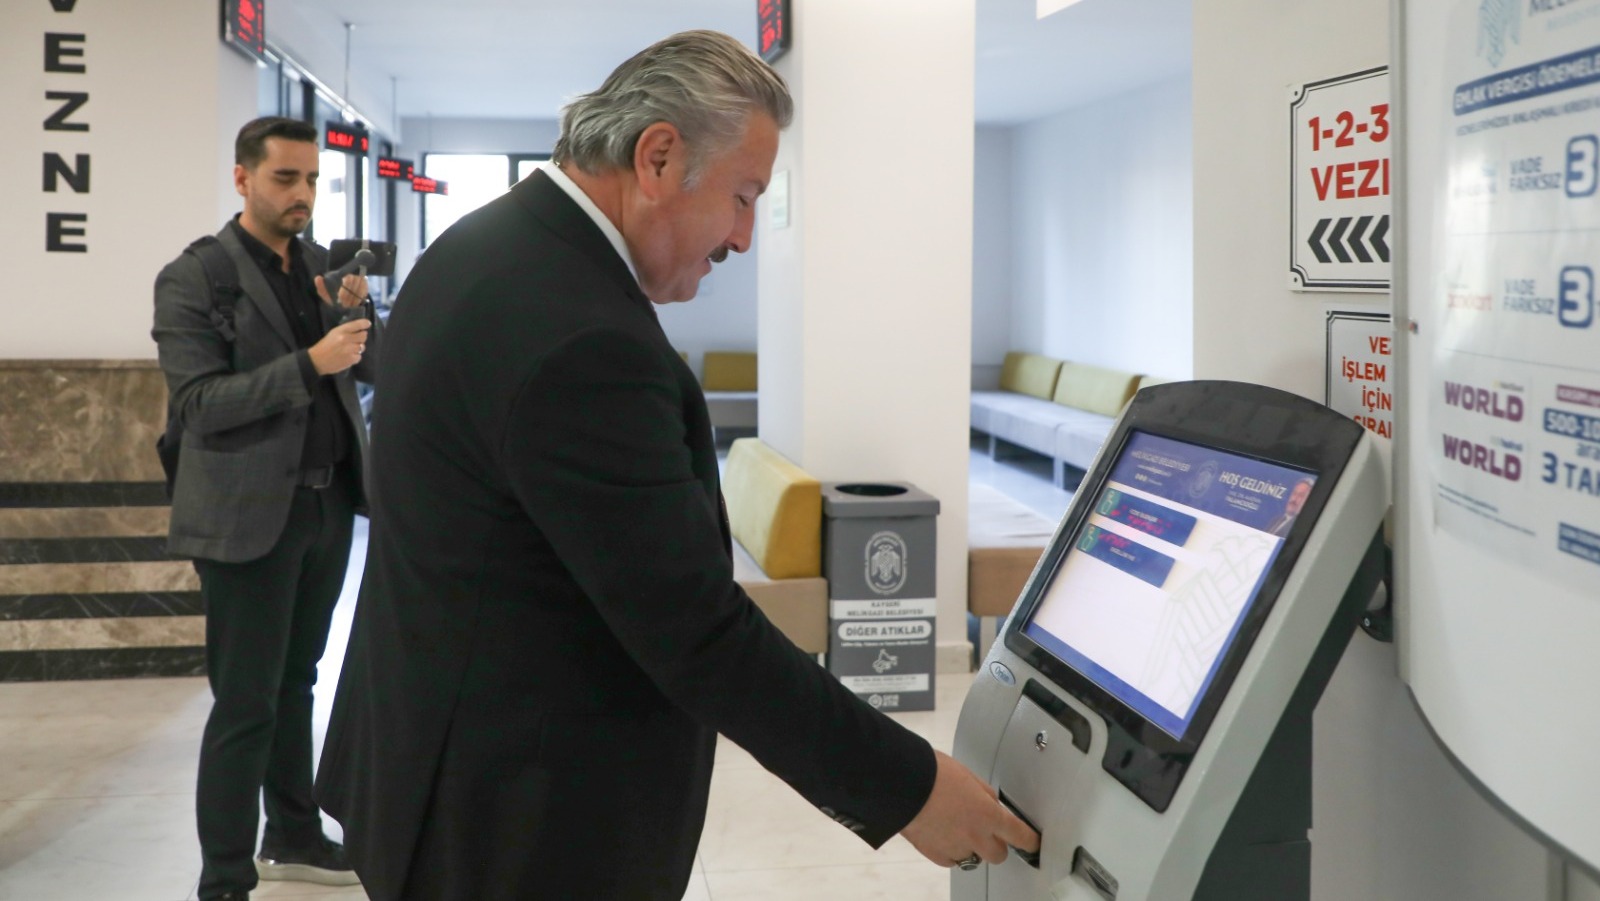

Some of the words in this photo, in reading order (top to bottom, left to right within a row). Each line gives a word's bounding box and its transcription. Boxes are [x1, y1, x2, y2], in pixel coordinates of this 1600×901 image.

[1308, 103, 1389, 151] 1-2-3
[1310, 158, 1389, 201] VEZ
[1565, 134, 1599, 198] 3
[1558, 265, 1594, 329] 3
[1342, 356, 1386, 382] İŞLEM
[1362, 385, 1391, 412] İÇİN
[1444, 380, 1523, 423] WORLD
[1443, 433, 1521, 482] WORLD
[1542, 452, 1557, 484] 3
[1219, 471, 1241, 489] HOŞ
[1240, 476, 1287, 499] GELDİNİZ
[846, 624, 878, 637] DİĞER
[881, 625, 924, 636] ATIKLAR
